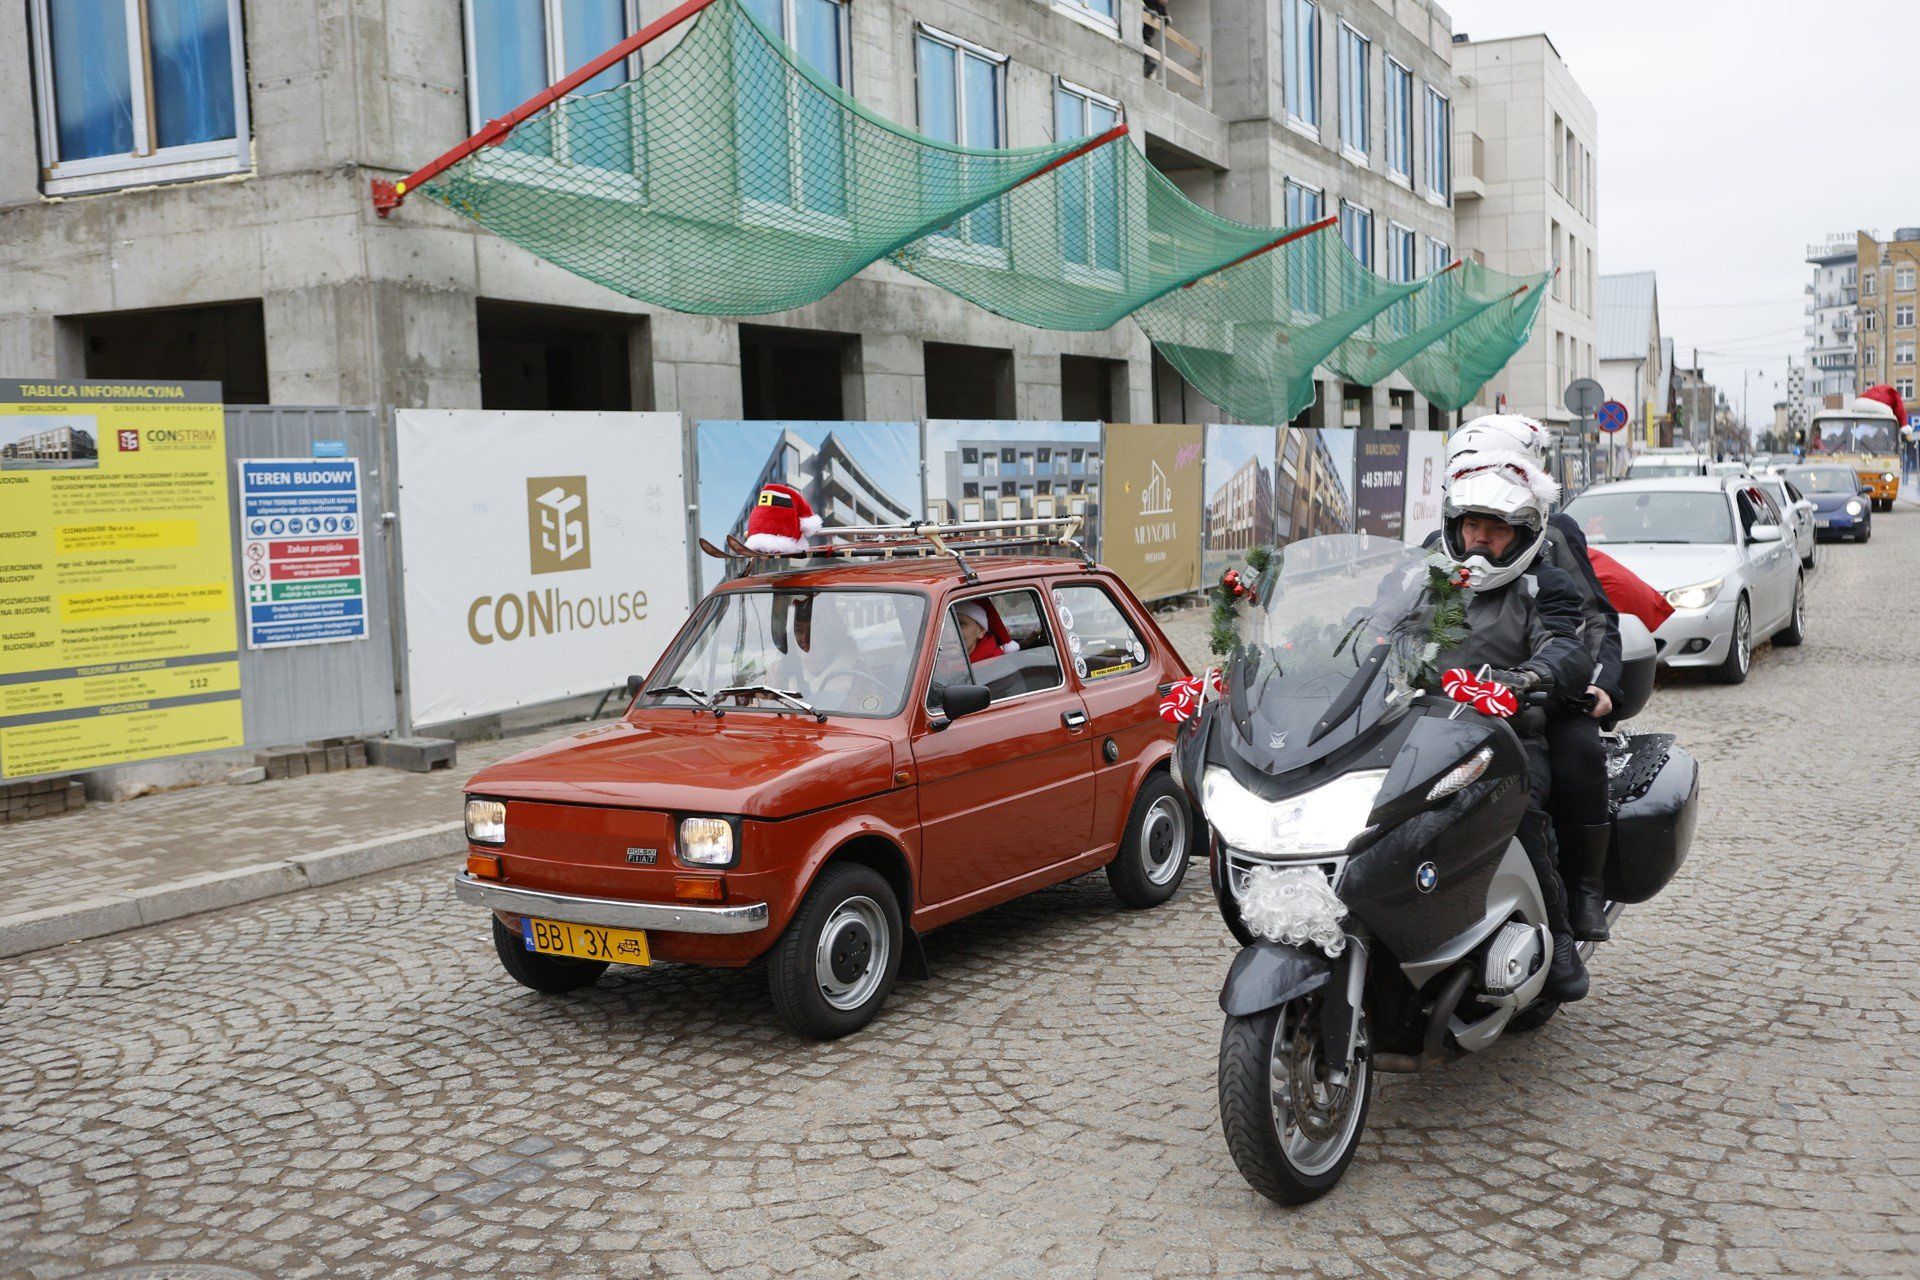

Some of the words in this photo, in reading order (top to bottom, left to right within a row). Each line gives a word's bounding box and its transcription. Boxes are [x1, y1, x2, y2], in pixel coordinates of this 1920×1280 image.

[19, 384, 78, 398] TABLICA
[80, 385, 185, 399] INFORMACYJNA
[146, 430, 216, 442] CONSTRIM
[247, 472, 290, 485] TEREN
[293, 470, 354, 485] BUDOWY
[286, 545, 310, 554] Zakaz
[467, 588, 648, 645] CONhouse
[190, 678, 209, 689] 112
[628, 855, 656, 863] FIAT
[584, 929, 613, 958] 3X
